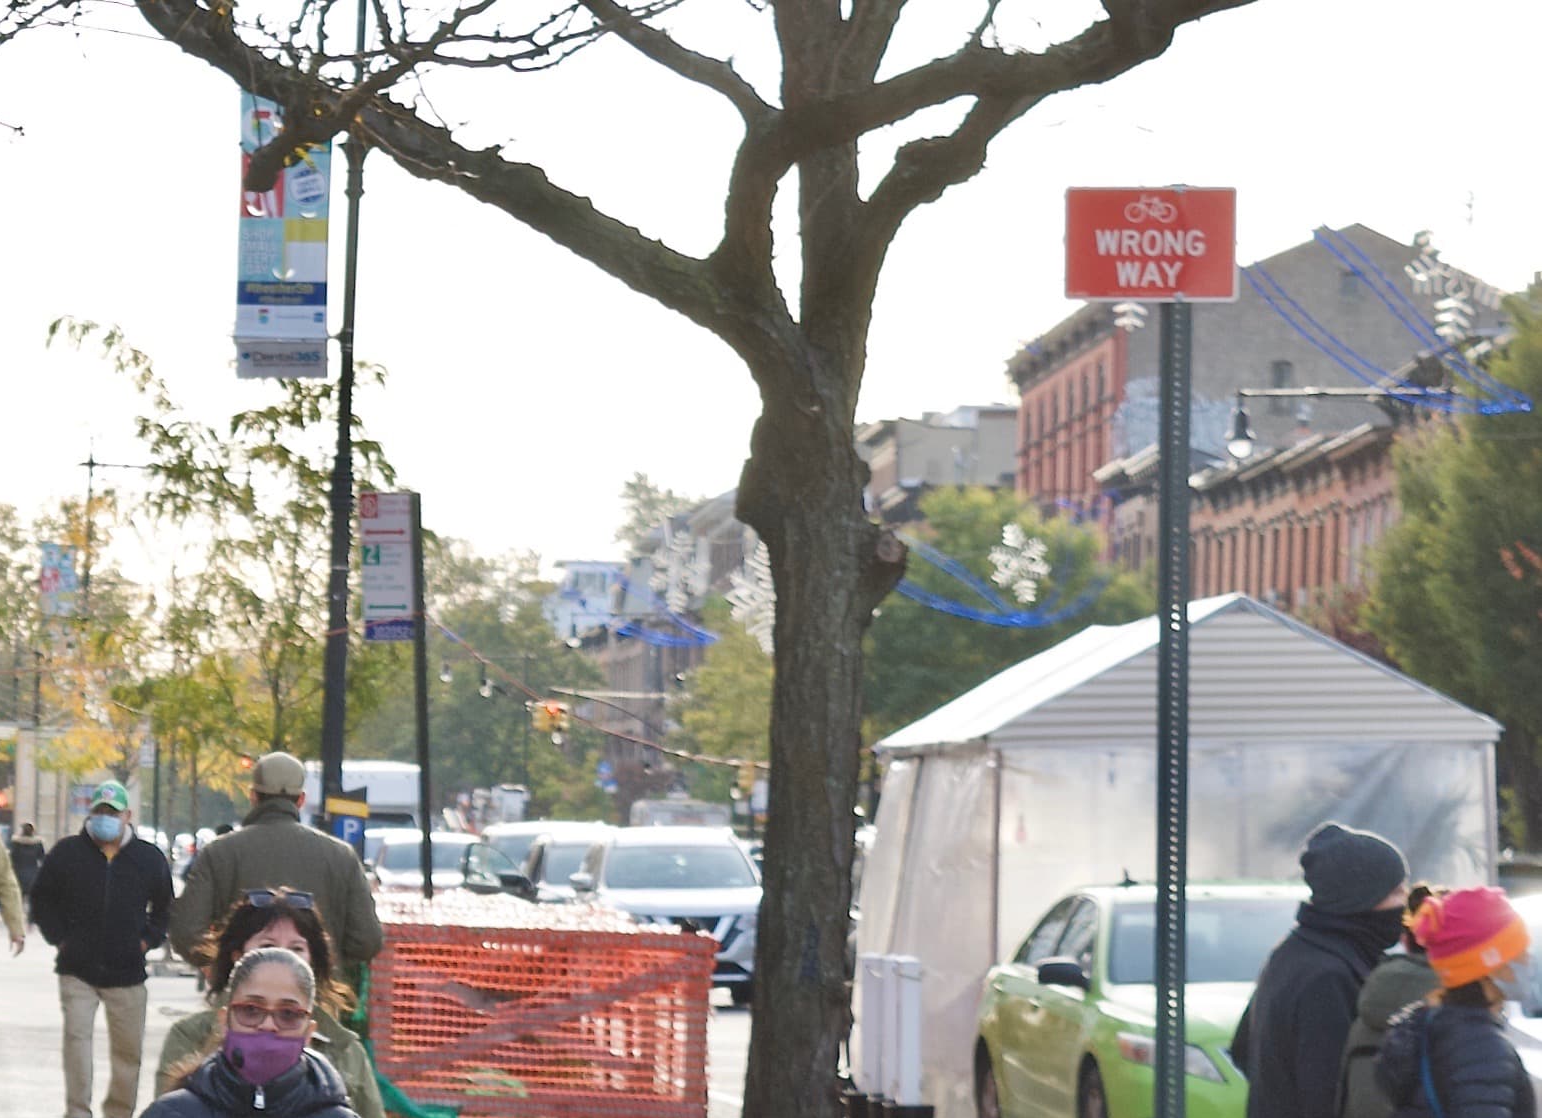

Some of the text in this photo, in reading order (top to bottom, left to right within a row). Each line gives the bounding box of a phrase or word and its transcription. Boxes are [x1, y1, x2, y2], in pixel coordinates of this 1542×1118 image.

[1095, 229, 1206, 257] WRONG
[1116, 261, 1184, 288] WAY
[343, 818, 361, 841] P
